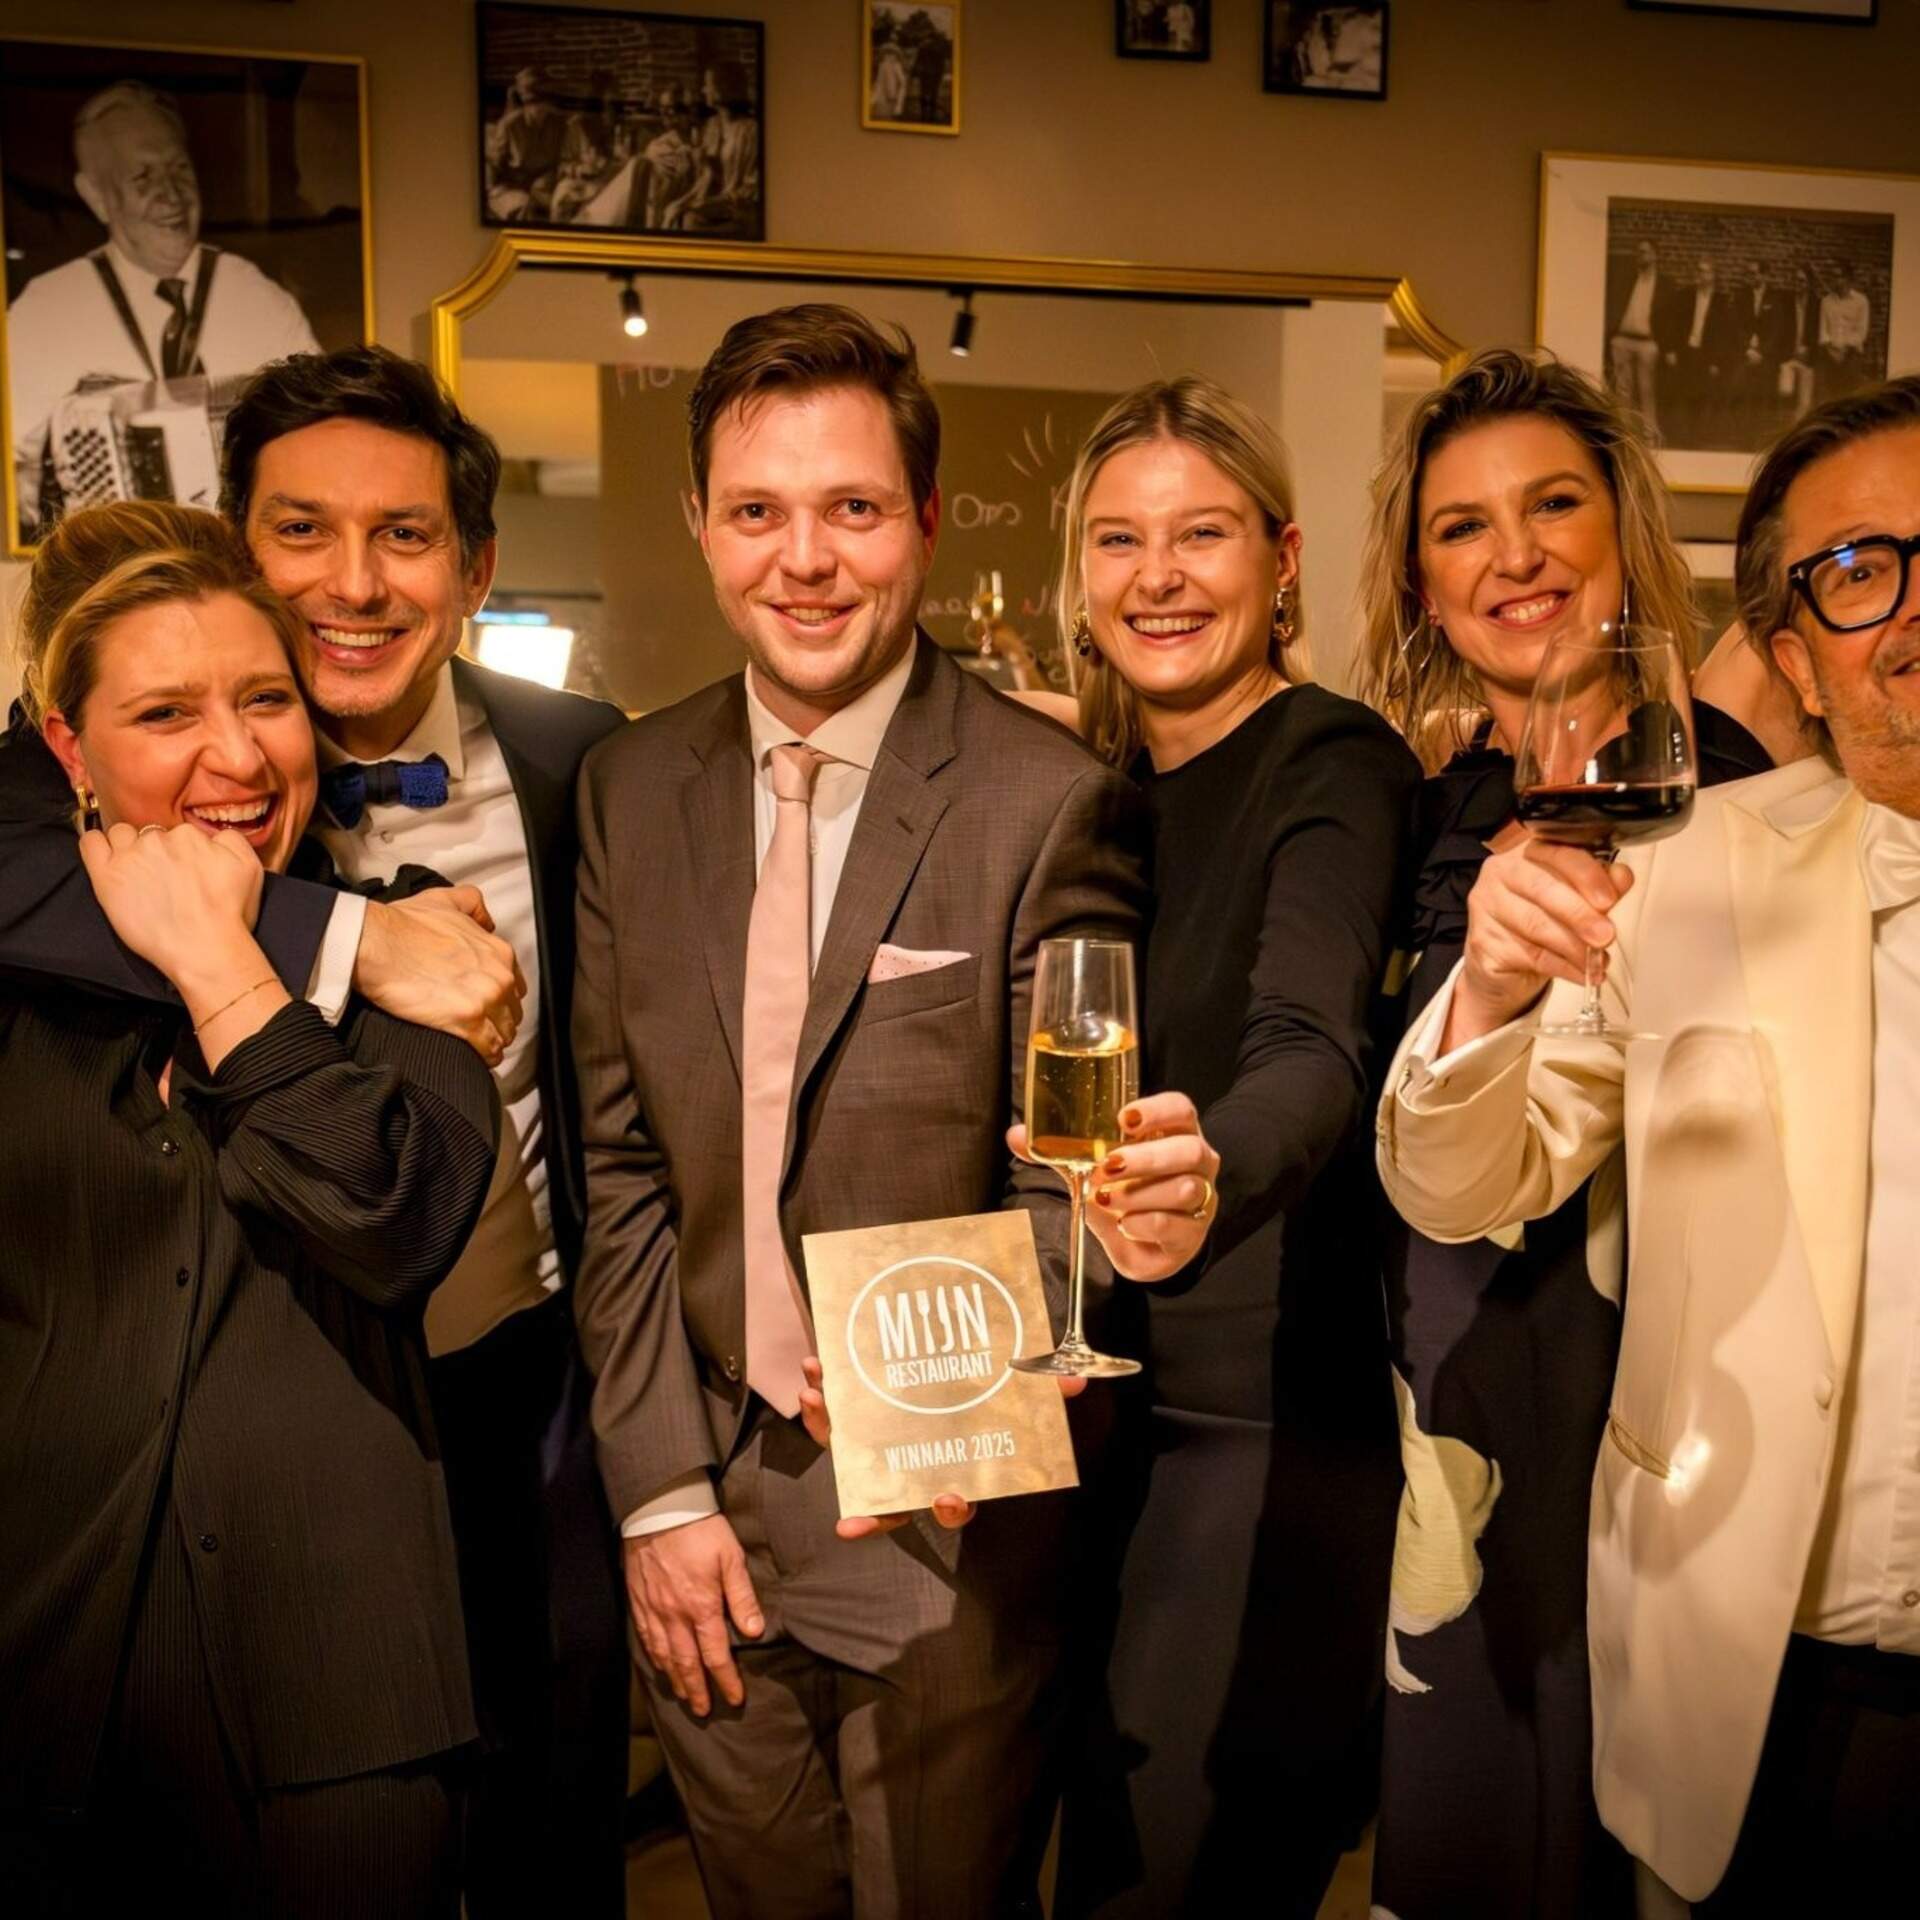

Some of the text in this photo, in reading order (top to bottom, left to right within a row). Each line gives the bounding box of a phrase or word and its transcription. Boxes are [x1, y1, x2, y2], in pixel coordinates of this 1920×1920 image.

[875, 1283, 990, 1360] MIJN
[886, 1351, 992, 1388] RESTAURANT
[886, 1431, 1015, 1472] WINNAAR 2025
